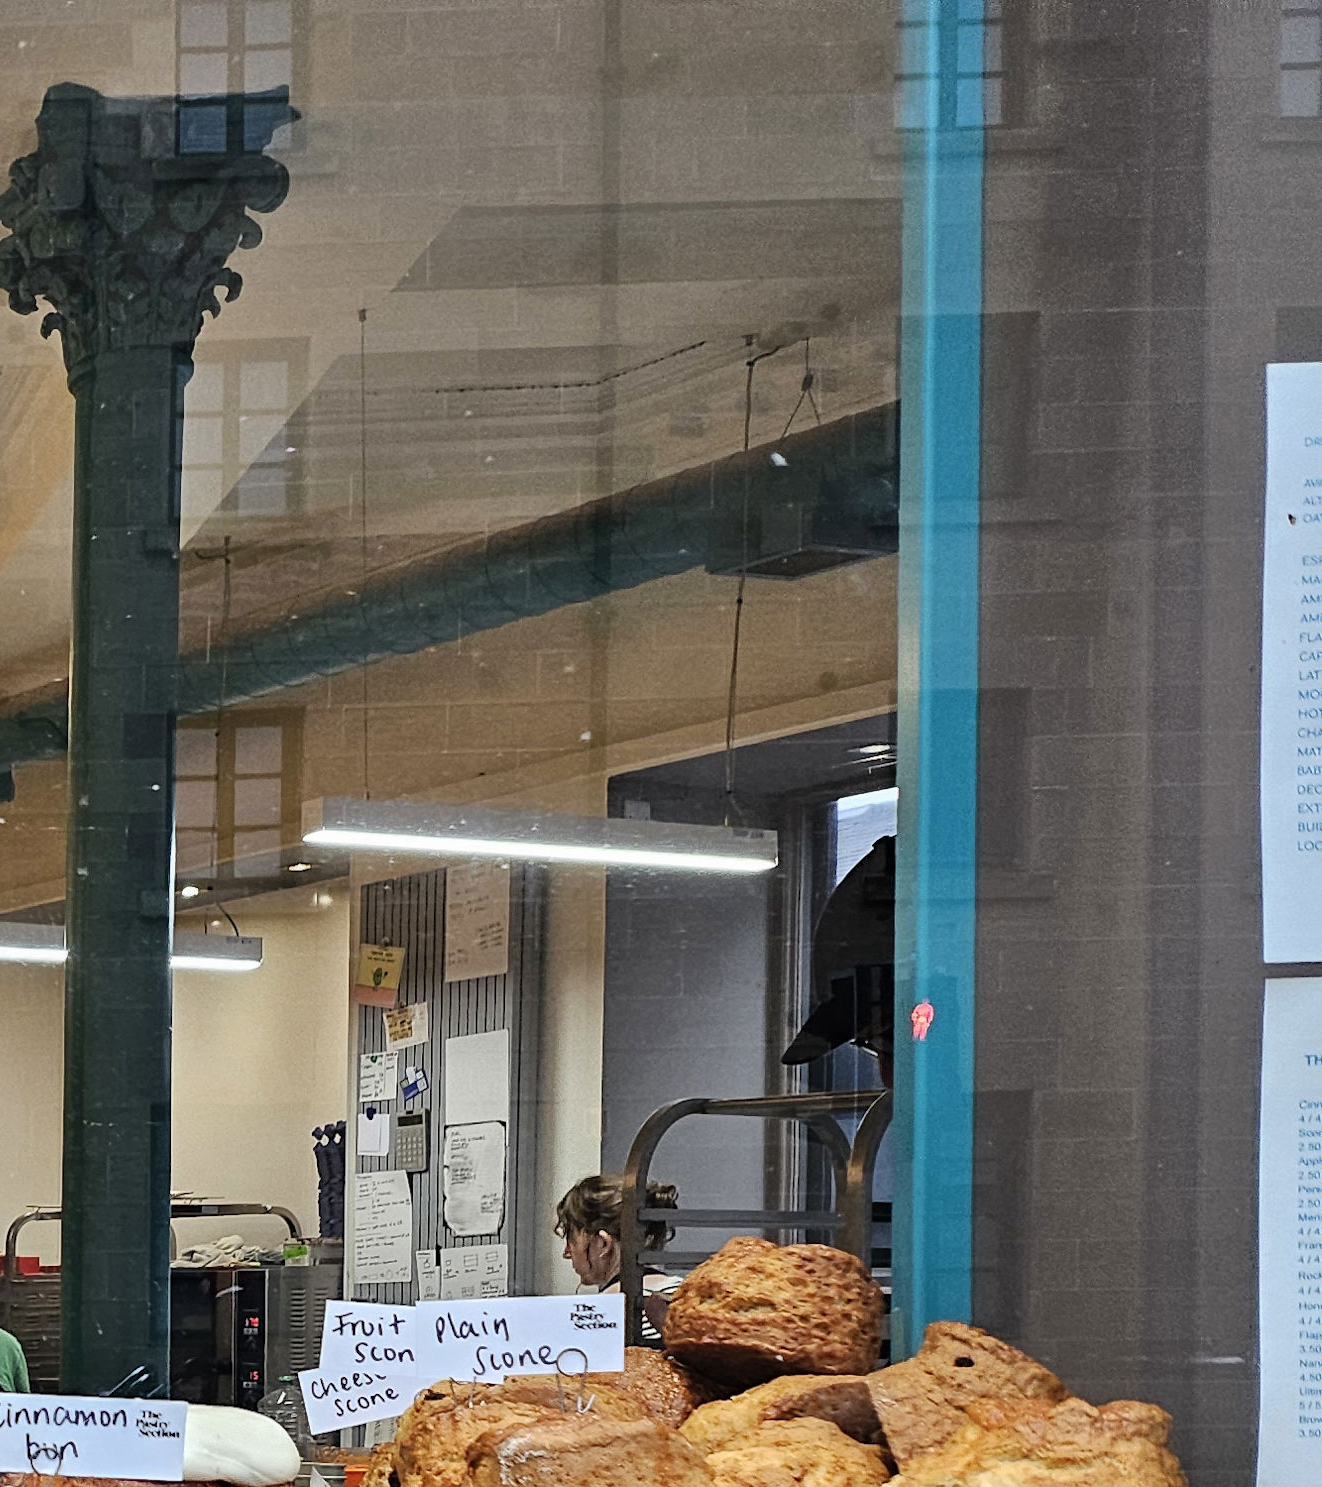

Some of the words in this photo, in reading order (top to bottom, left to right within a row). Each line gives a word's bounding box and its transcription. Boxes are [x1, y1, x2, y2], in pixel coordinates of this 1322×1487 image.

[573, 1303, 596, 1313] The
[333, 1312, 406, 1337] Fruit
[573, 1321, 618, 1331] Section
